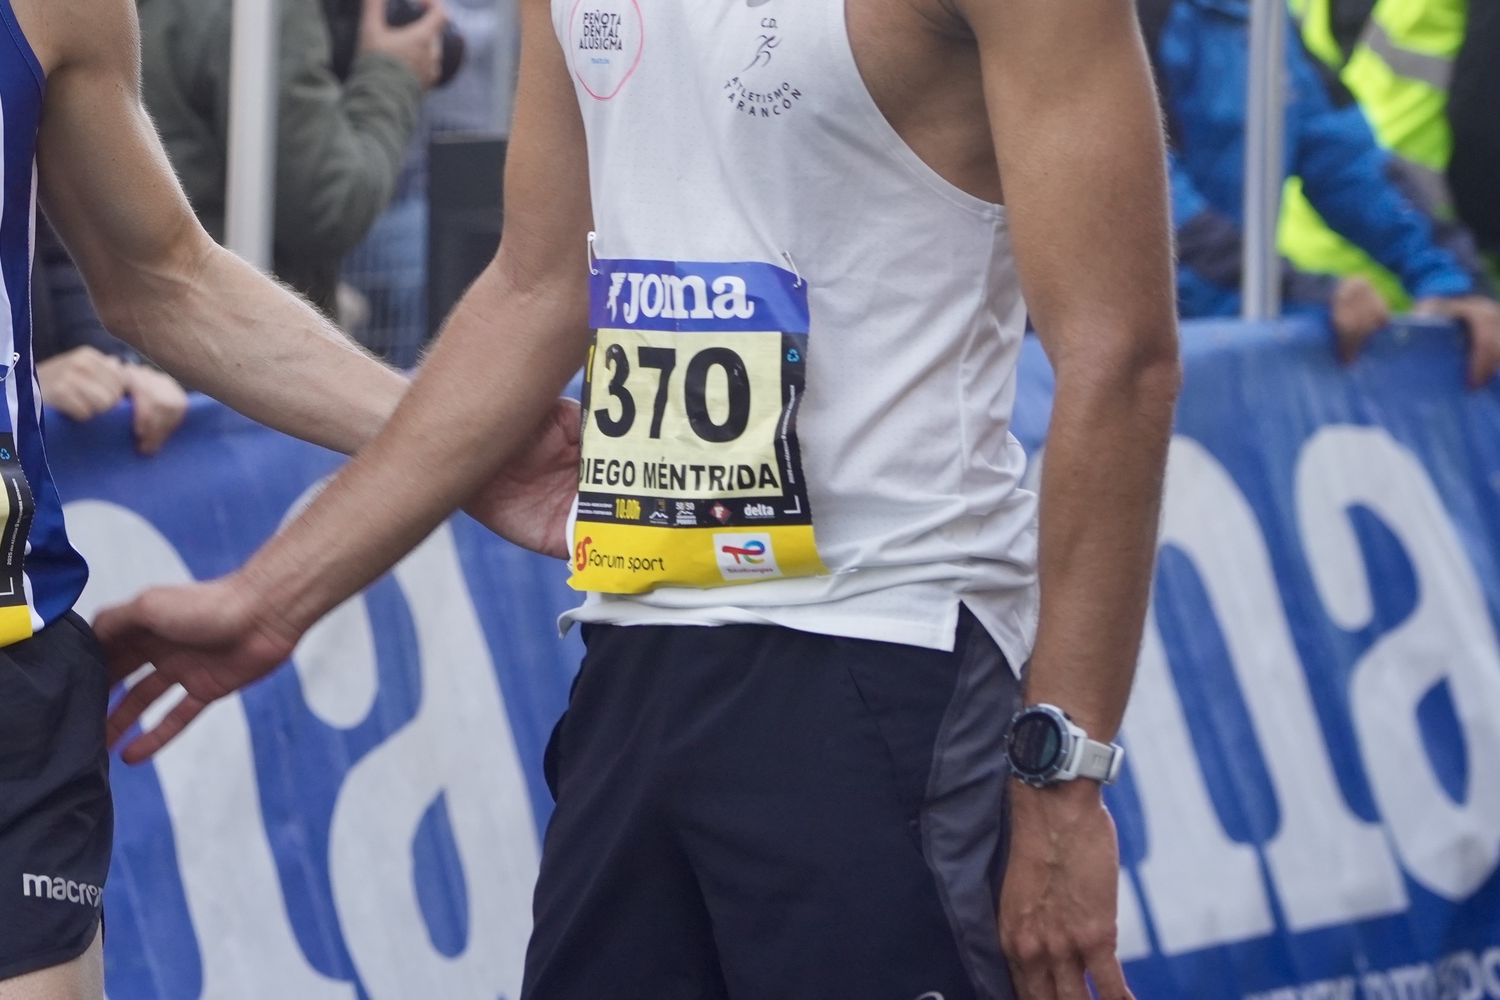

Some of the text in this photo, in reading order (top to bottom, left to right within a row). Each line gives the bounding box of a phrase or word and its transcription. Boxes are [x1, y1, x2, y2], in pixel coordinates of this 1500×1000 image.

[583, 10, 621, 25] PEÑOTA
[584, 25, 619, 37] DENTAL
[579, 38, 623, 50] ALUSIGMA
[732, 76, 790, 103] ATLETISMO
[623, 273, 755, 324] Joma
[594, 343, 751, 443] 370
[644, 456, 780, 491] MÉNTRIDA
[744, 504, 775, 516] delta
[628, 556, 665, 573] sport
